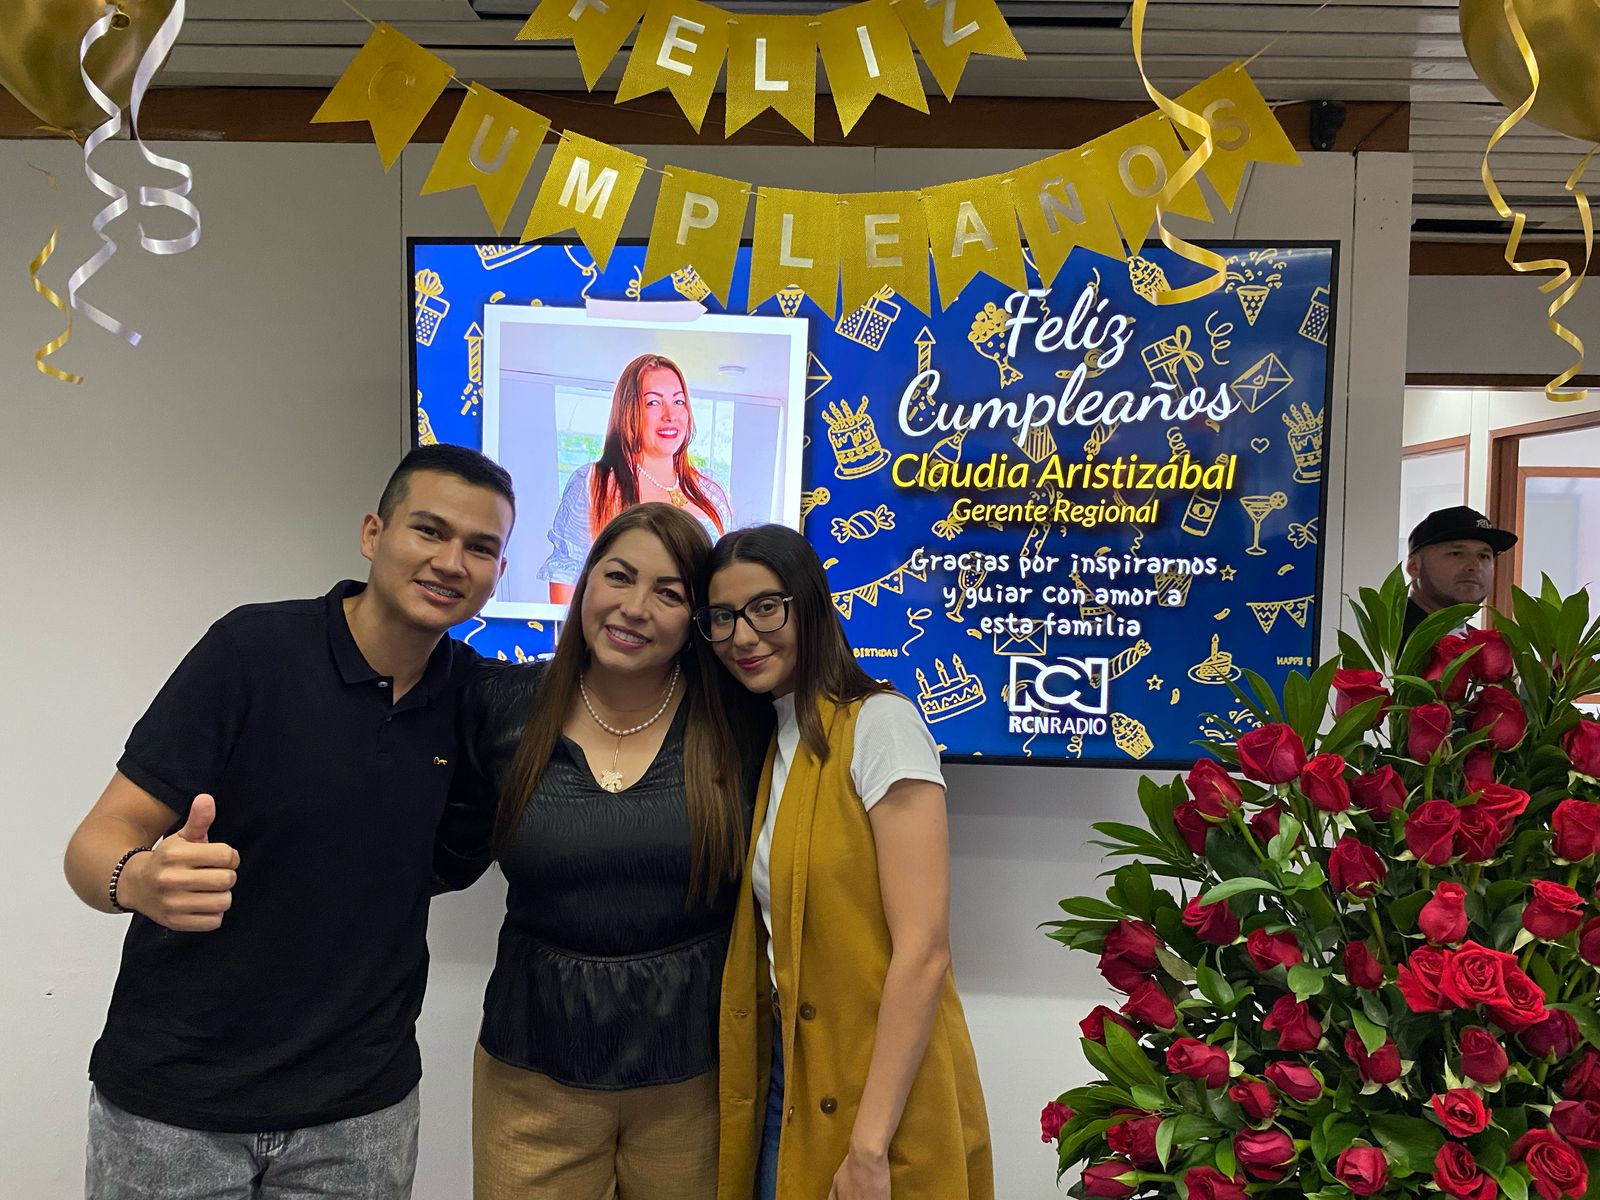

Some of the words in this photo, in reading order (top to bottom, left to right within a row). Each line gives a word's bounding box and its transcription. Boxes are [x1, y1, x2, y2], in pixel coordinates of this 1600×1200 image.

[568, 0, 980, 92] ELIZ
[898, 362, 1241, 448] Cumpleaños
[891, 453, 1030, 488] Claudia
[1036, 453, 1237, 490] Aristizábal
[952, 498, 1047, 522] Gerente
[1053, 499, 1159, 527] Regional
[911, 546, 1009, 571] Gracias
[1019, 554, 1059, 579] por
[1070, 553, 1217, 580] inspirarnos
[943, 586, 957, 608] y
[965, 584, 1033, 609] guiar
[1042, 585, 1086, 605] con
[1095, 587, 1159, 605] amor
[1167, 588, 1182, 605] a
[980, 612, 1034, 634] esta
[1043, 612, 1141, 637] familia
[853, 647, 898, 658] BIRTHDAY
[1276, 656, 1303, 666] HAPPY
